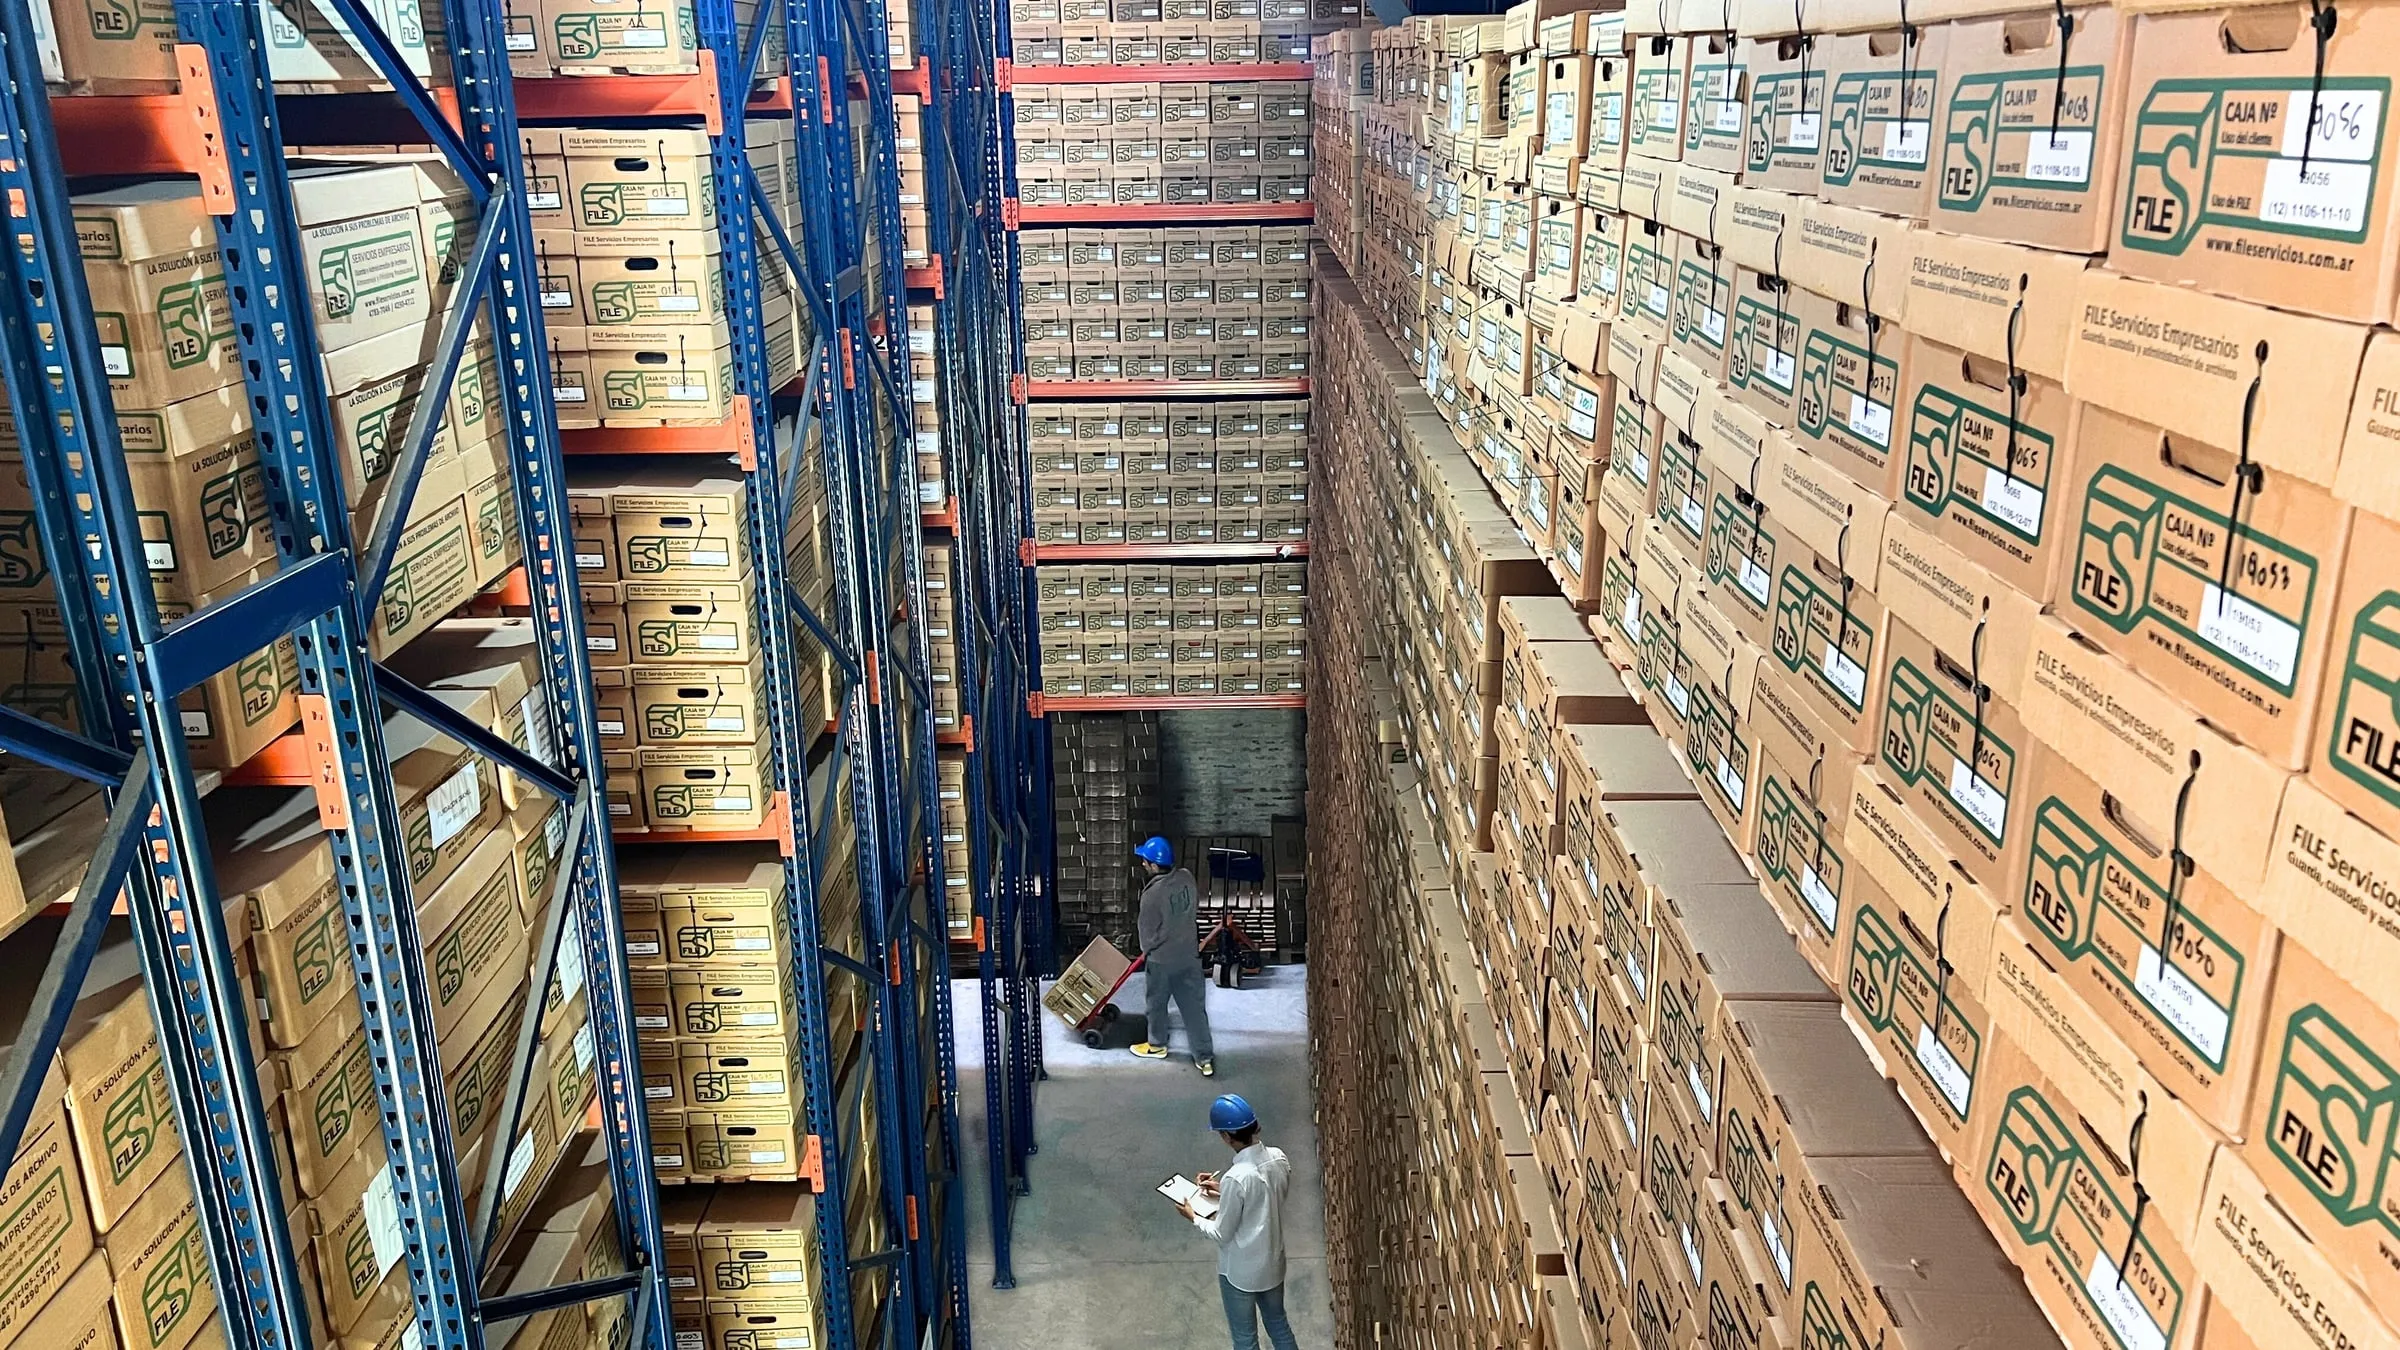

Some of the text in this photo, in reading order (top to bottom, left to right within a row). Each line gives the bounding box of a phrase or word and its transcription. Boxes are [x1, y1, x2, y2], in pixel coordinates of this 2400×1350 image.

[96, 12, 124, 30] FILE
[563, 44, 585, 55] FILE
[1869, 87, 1881, 100] CAJA
[2005, 89, 2024, 106] CAJA
[2225, 102, 2256, 123] CAJA
[1688, 121, 1698, 141] FILE
[1752, 141, 1765, 161] FILE
[1829, 149, 1846, 173] FILE
[1859, 173, 1921, 188] www.fileservicios.com.ar
[1946, 168, 1974, 195] FILE
[587, 210, 609, 220] FILE
[1992, 195, 2083, 213] www.fileservicios.com.ar
[2133, 196, 2176, 233] FILE
[2293, 204, 2350, 221] 1106-11-10
[1803, 218, 1867, 246] FILE Servicios Empresarios
[148, 265, 157, 275] LA
[195, 256, 199, 264] A
[201, 253, 212, 264] SUS
[2206, 235, 2355, 271] www.fileservicios.com.ar
[1913, 257, 2010, 291] FILE Servicios Empresarios
[599, 307, 621, 317] FILE
[2084, 305, 2239, 359] FILE Servicios Empresarios
[171, 338, 195, 357] FILE
[1733, 355, 1744, 377] FILE
[464, 402, 478, 419] FILE
[611, 398, 633, 407] FILE
[1802, 398, 1818, 425] FILE
[1963, 417, 1982, 437] CAJA
[192, 460, 202, 472] LA
[1911, 464, 1936, 500] FILE
[212, 526, 236, 550] FILE
[1952, 510, 2033, 565] www.fileservicios.com.ar
[2165, 512, 2195, 540] CAJA
[633, 560, 654, 569] FILE
[1889, 538, 1901, 557] FILE
[1903, 547, 1931, 576] Servicios
[1932, 565, 1974, 605] Empresarios
[2082, 562, 2120, 609] FILE
[389, 606, 405, 627] FILE
[644, 644, 665, 653] FILE
[1776, 626, 1794, 657] FILE
[2148, 629, 2282, 718] www.fileservicios.com.ar
[246, 692, 268, 717] FILE
[2036, 650, 2175, 756] FILE Servicios Empresarios
[652, 727, 672, 735] FILE
[1887, 729, 1909, 769] FILE
[660, 807, 680, 815] FILE
[1855, 792, 1871, 814] FILE
[1923, 787, 1997, 864] www.fileservicios.com.ar
[1761, 832, 1775, 866] FILE
[2292, 824, 2327, 861] FILE
[415, 853, 429, 876] FILE
[2107, 864, 2133, 897] CAJA
[2032, 880, 2067, 935] FILE
[285, 924, 294, 933] LA
[304, 969, 323, 997] FILE
[443, 975, 457, 998] FILE
[1853, 968, 1876, 1012] FILE
[1999, 951, 2124, 1091] FILE Servicios Empresarios
[2091, 966, 2212, 1089] www.fileservicios.com.ar
[92, 1088, 103, 1102] LA
[323, 1117, 342, 1146] FILE
[115, 1136, 142, 1173] FILE
[2280, 1109, 2339, 1191] FILE
[9, 1141, 58, 1195] DE ARCHIVO
[1995, 1157, 2030, 1217] FILE
[2074, 1168, 2098, 1203] CAJA
[132, 1210, 186, 1271] LA A
[2219, 1194, 2248, 1236] FILE
[2248, 1227, 2312, 1308] Servicios
[354, 1261, 376, 1292] FILE
[154, 1299, 179, 1336] FILE
